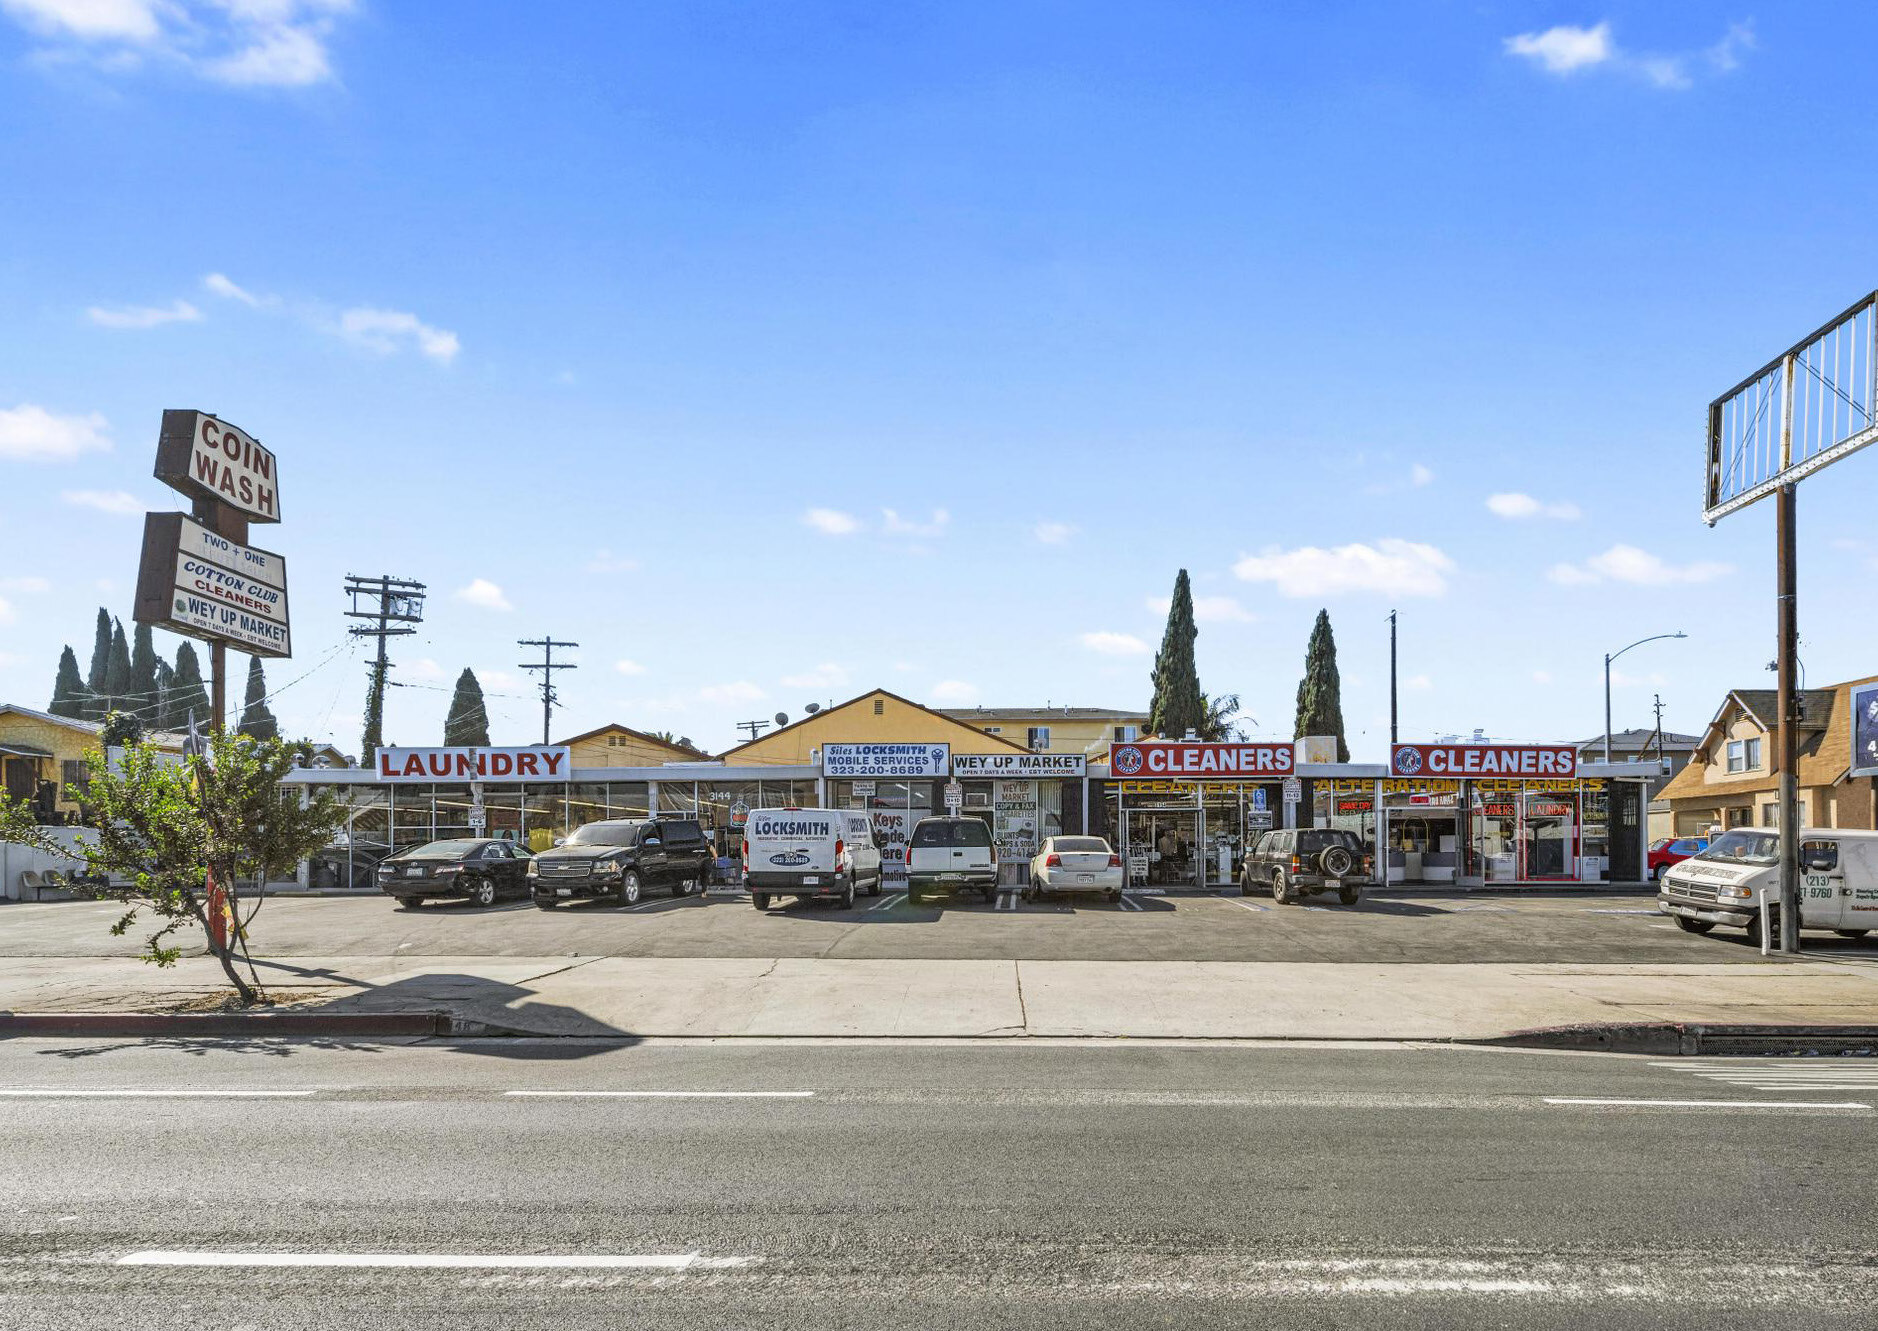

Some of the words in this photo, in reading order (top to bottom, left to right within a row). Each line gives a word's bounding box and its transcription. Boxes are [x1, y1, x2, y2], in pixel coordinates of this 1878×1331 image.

[201, 419, 270, 480] COIN
[196, 451, 273, 515] WASH
[203, 532, 229, 551] TWO
[244, 550, 266, 567] ONE
[184, 561, 245, 590] COTTON
[247, 585, 278, 604] CLUB
[195, 579, 272, 614] CLEANERS
[188, 597, 217, 620] WEY
[220, 608, 237, 626] UP
[240, 614, 287, 642] MARKET
[193, 617, 207, 628] OPEN
[212, 622, 224, 633] DAYS
[830, 745, 852, 755] Siles
[855, 746, 927, 755] LOCKSMITH
[381, 752, 565, 777] LAUNDRY
[828, 756, 869, 765] MOBILE
[873, 756, 929, 765] SERVICES
[954, 757, 990, 768] WEY
[993, 757, 1013, 768] UP
[1020, 756, 1083, 768] MARKET
[1148, 748, 1292, 772] CLEANERS
[1428, 749, 1574, 773] CLEANERS
[831, 766, 924, 775] 323-200-8689
[1002, 783, 1018, 793] WEY
[1122, 781, 1260, 793] CLEANERS
[1477, 779, 1604, 792] CLEANERS
[709, 791, 731, 801] 3144
[1530, 803, 1571, 816] LAUNDRY
[755, 821, 829, 835] LOCKSMITH
[873, 813, 903, 829] Keys
[1020, 840, 1035, 848] SODA
[1806, 874, 1830, 887] (213)
